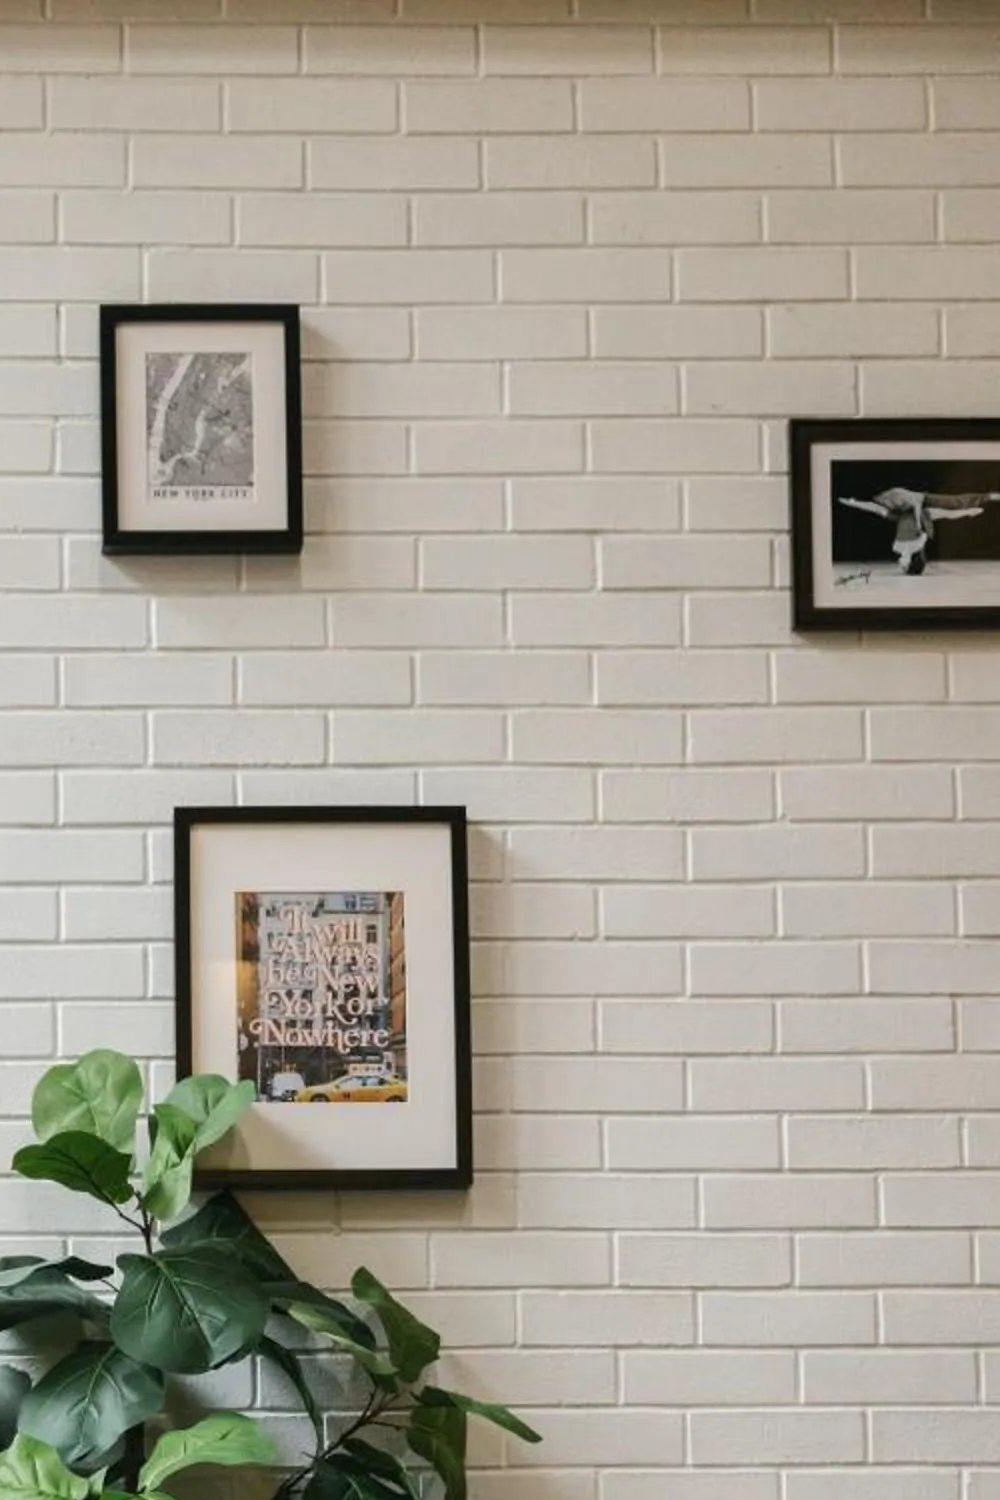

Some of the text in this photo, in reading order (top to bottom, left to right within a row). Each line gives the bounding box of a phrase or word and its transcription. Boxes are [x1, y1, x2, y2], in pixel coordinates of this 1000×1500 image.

[153, 489, 248, 498] NEW YORK CITY
[318, 965, 380, 992] New
[265, 989, 380, 1024] York or
[249, 1018, 389, 1054] Nowhere
